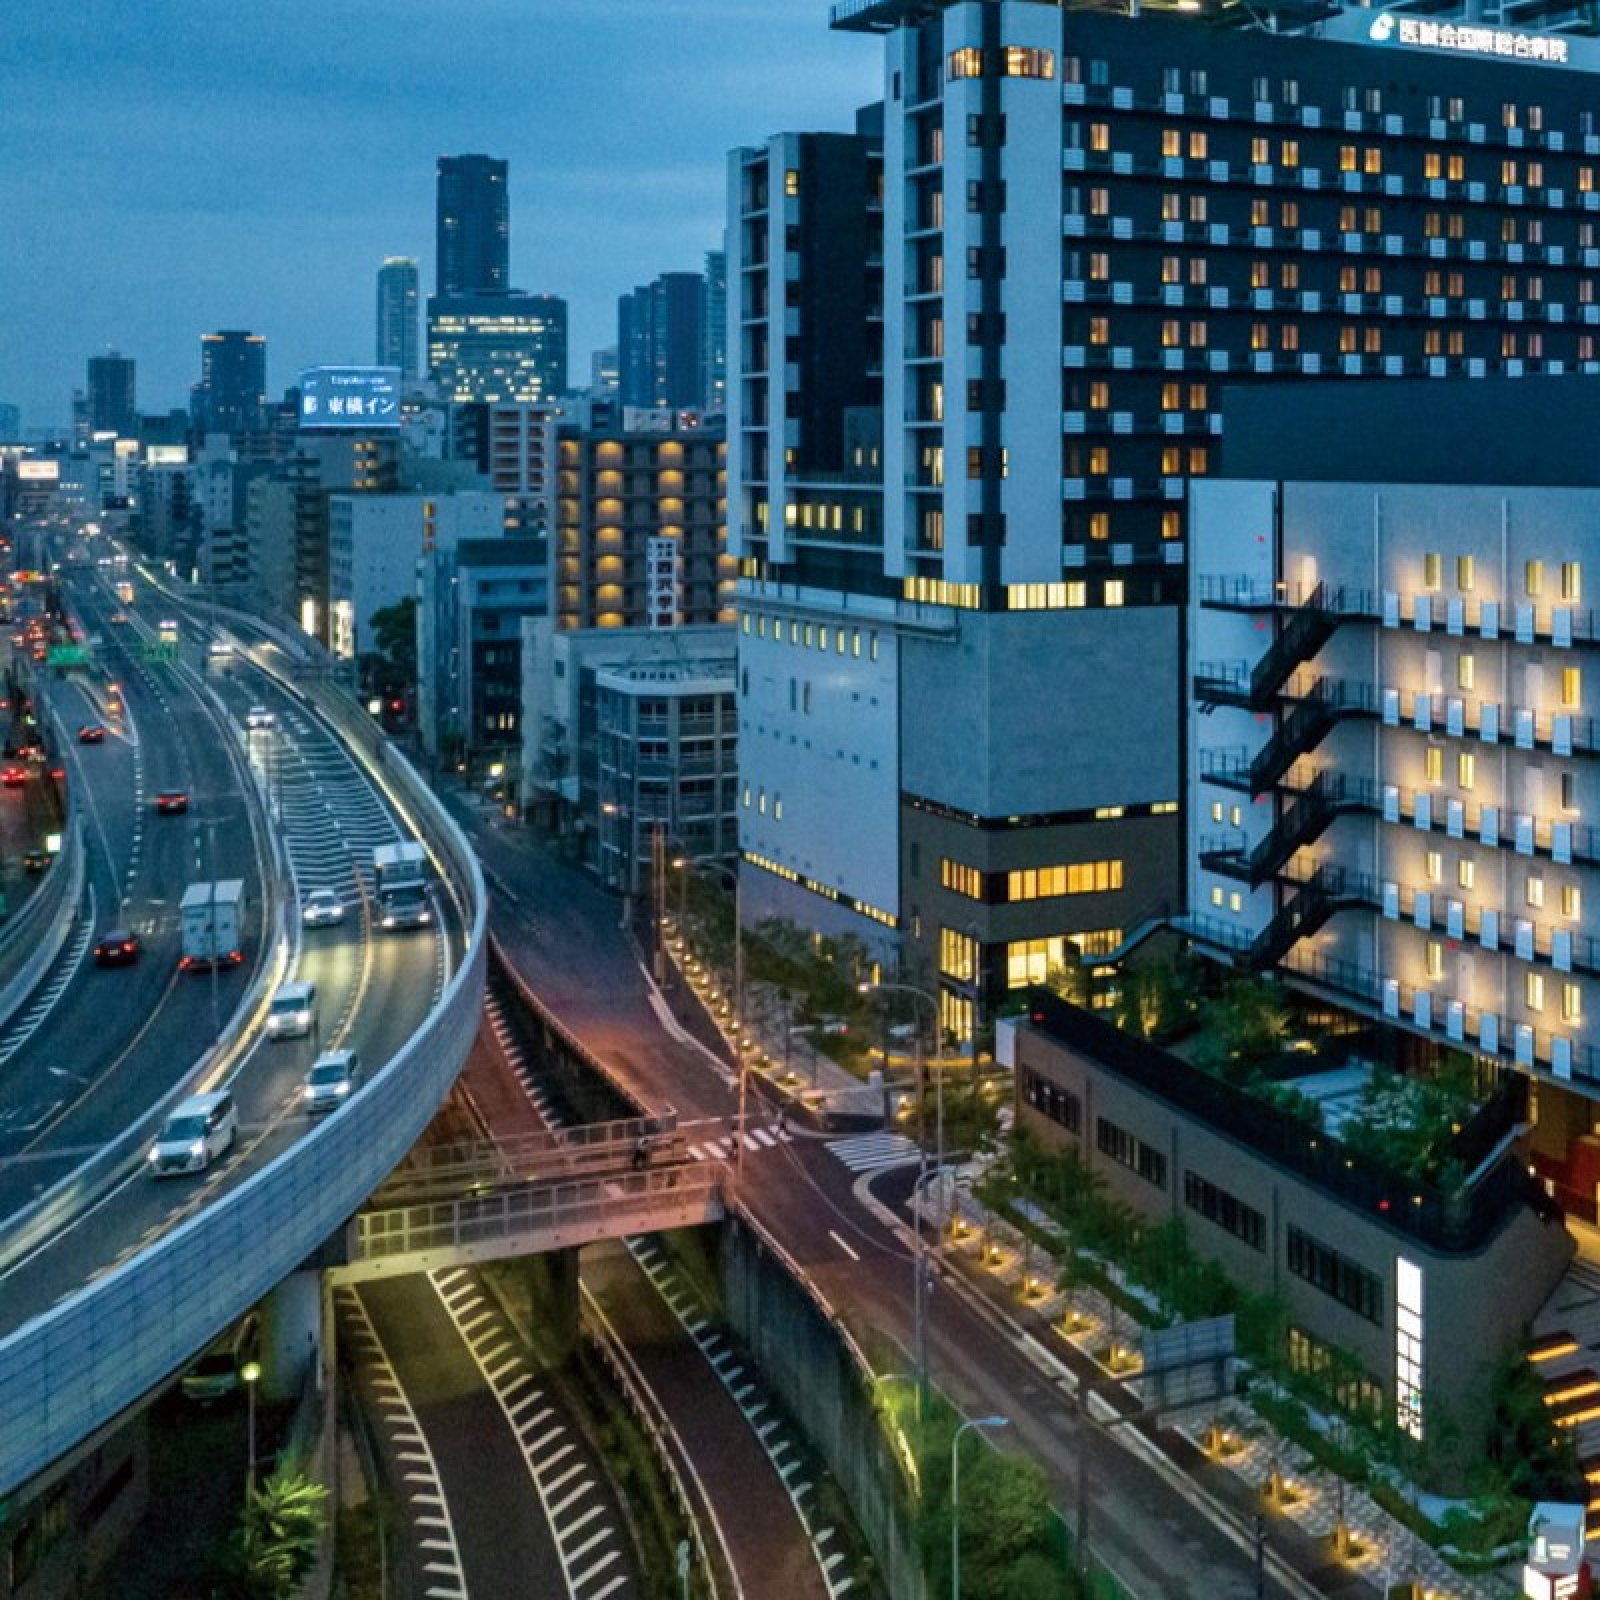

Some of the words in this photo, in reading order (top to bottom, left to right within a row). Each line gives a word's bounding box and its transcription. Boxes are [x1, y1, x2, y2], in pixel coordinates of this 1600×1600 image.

[1399, 19, 1568, 62] 医誠会国際総合病院
